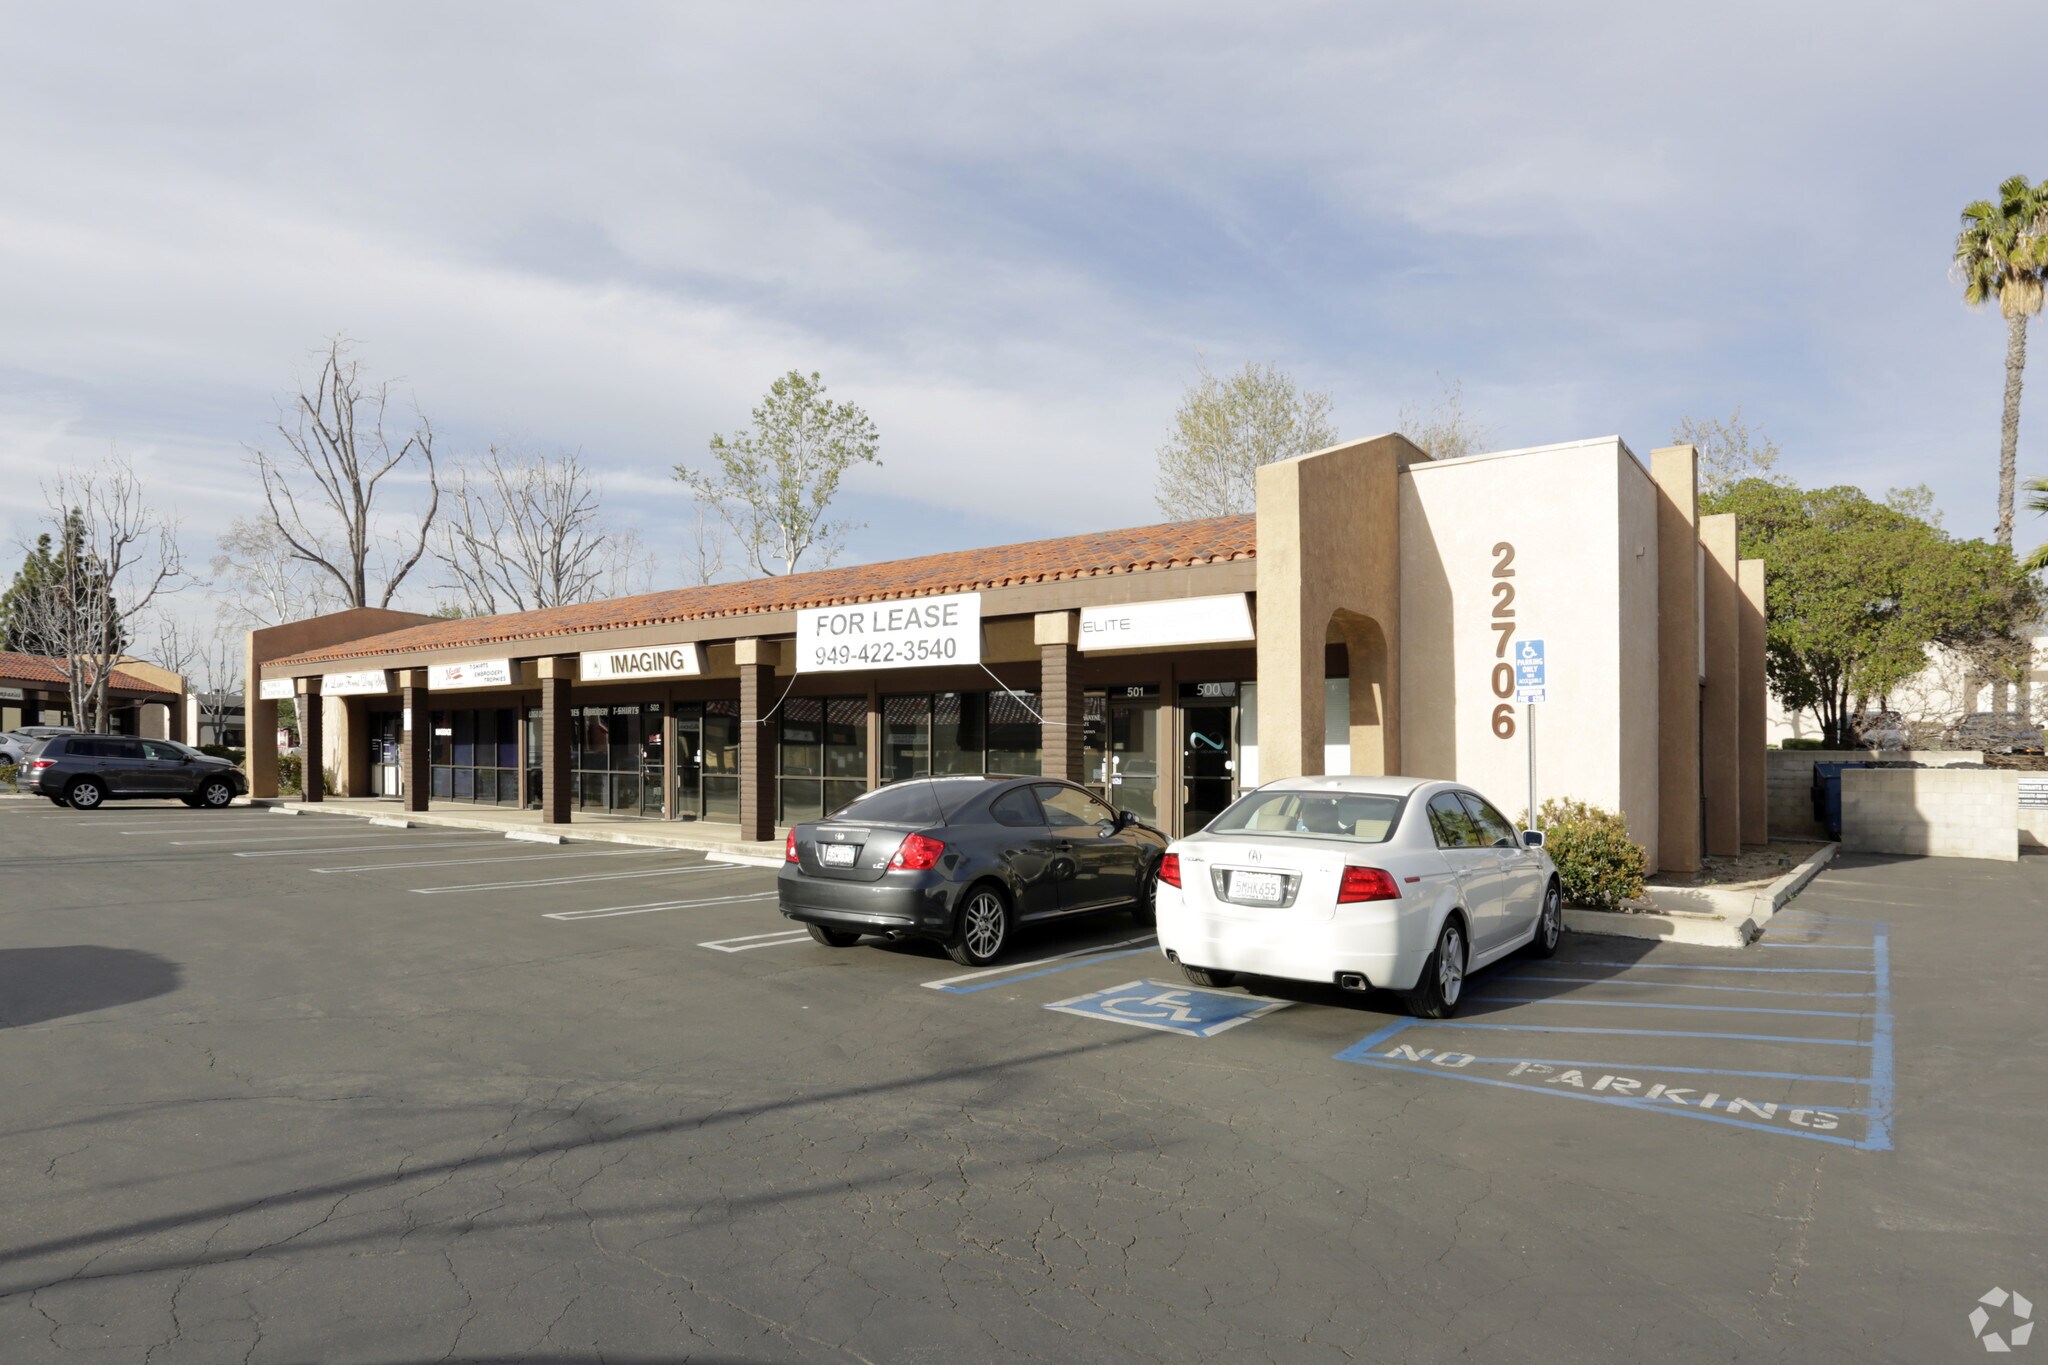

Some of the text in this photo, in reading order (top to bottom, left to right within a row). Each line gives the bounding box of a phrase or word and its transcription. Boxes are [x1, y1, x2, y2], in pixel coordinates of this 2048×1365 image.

[816, 602, 960, 637] FOR LEASE
[1082, 618, 1131, 633] ELITE
[1491, 541, 1516, 740] 22706
[815, 637, 957, 666] 949-422-3540
[610, 650, 685, 674] IMAGING
[1127, 687, 1144, 698] 501
[1196, 683, 1220, 696] 500
[613, 706, 640, 716] T-SHIRTS
[650, 703, 660, 712] 502
[1236, 880, 1277, 896] 5MHK655
[1384, 1043, 1840, 1131] NO PARKING
